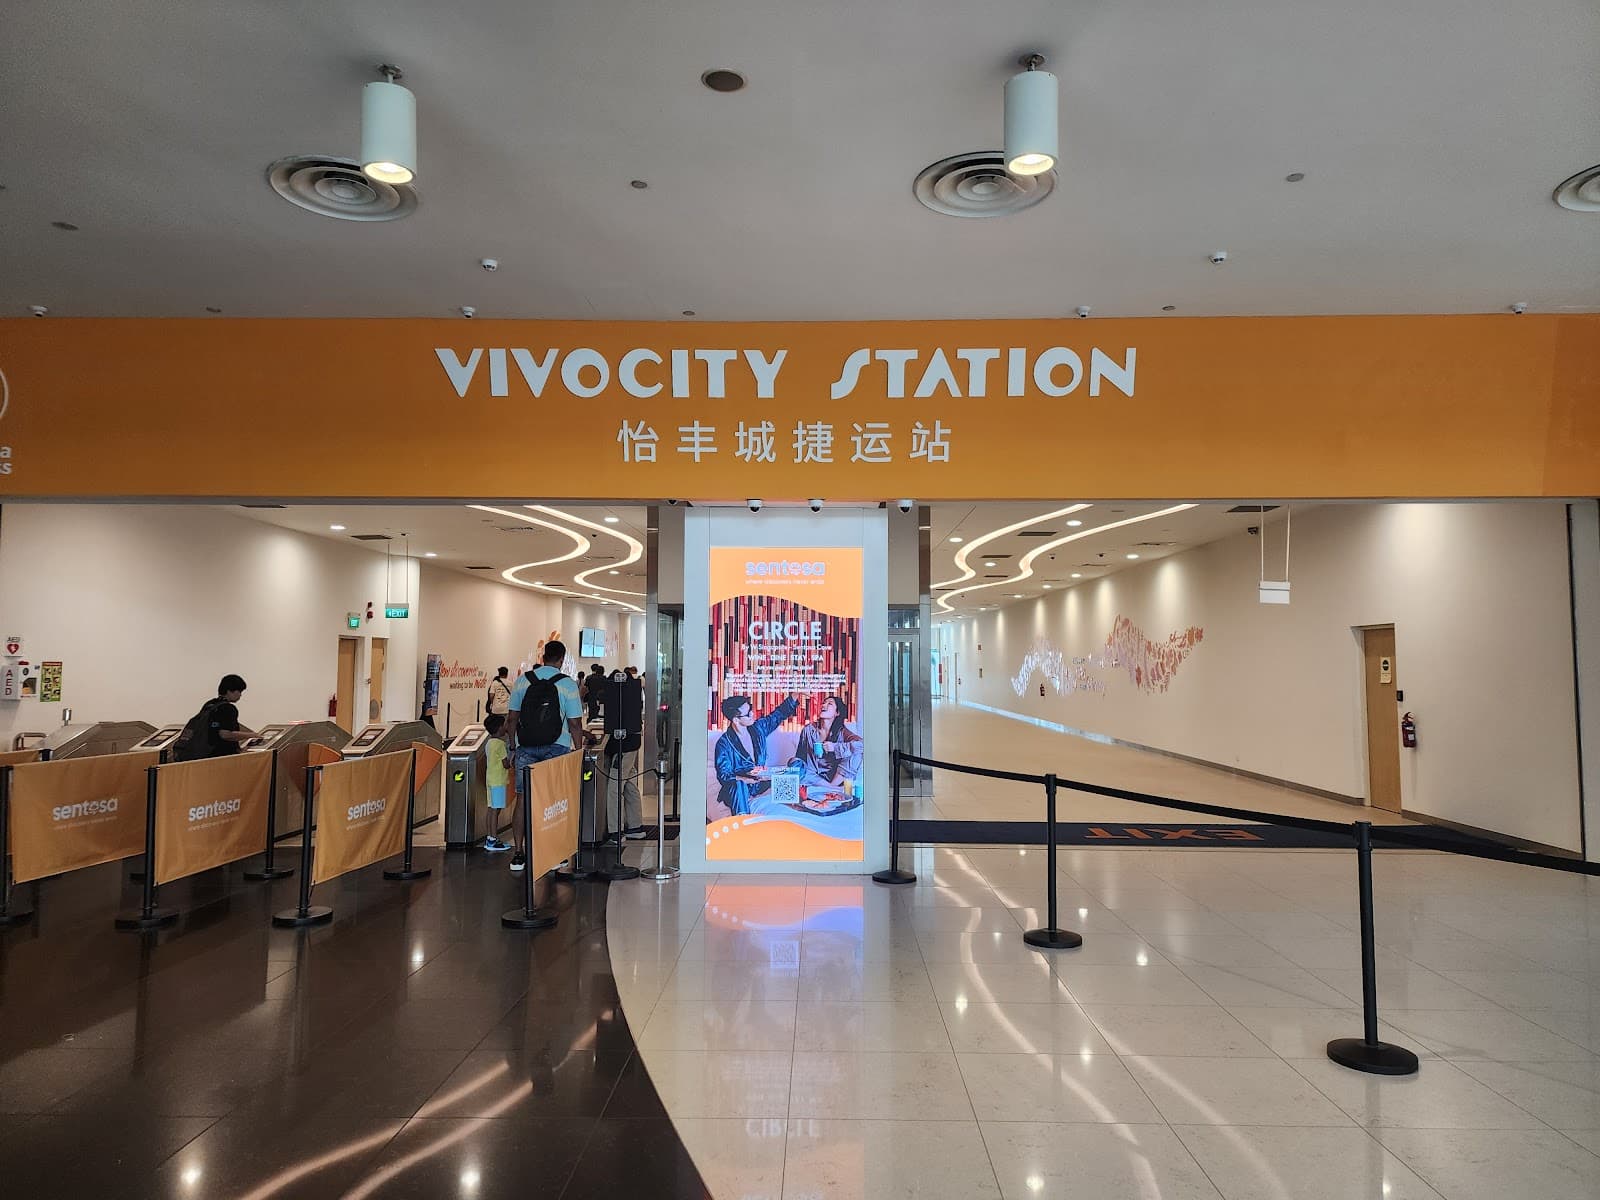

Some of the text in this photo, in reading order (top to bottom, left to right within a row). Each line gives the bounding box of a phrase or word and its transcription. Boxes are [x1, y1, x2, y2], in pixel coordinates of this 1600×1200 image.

[434, 346, 1137, 400] VIVOCITY STATION
[616, 419, 952, 464] 怡丰城捷运站
[745, 560, 825, 577] sentosa
[391, 608, 406, 618] EXIT
[748, 620, 822, 640] CIRCLE
[5, 669, 13, 696] AED
[52, 798, 118, 821] sentosa
[188, 798, 241, 821] sentosa
[347, 798, 386, 821] sentosa
[1084, 827, 1265, 841] EXIT
